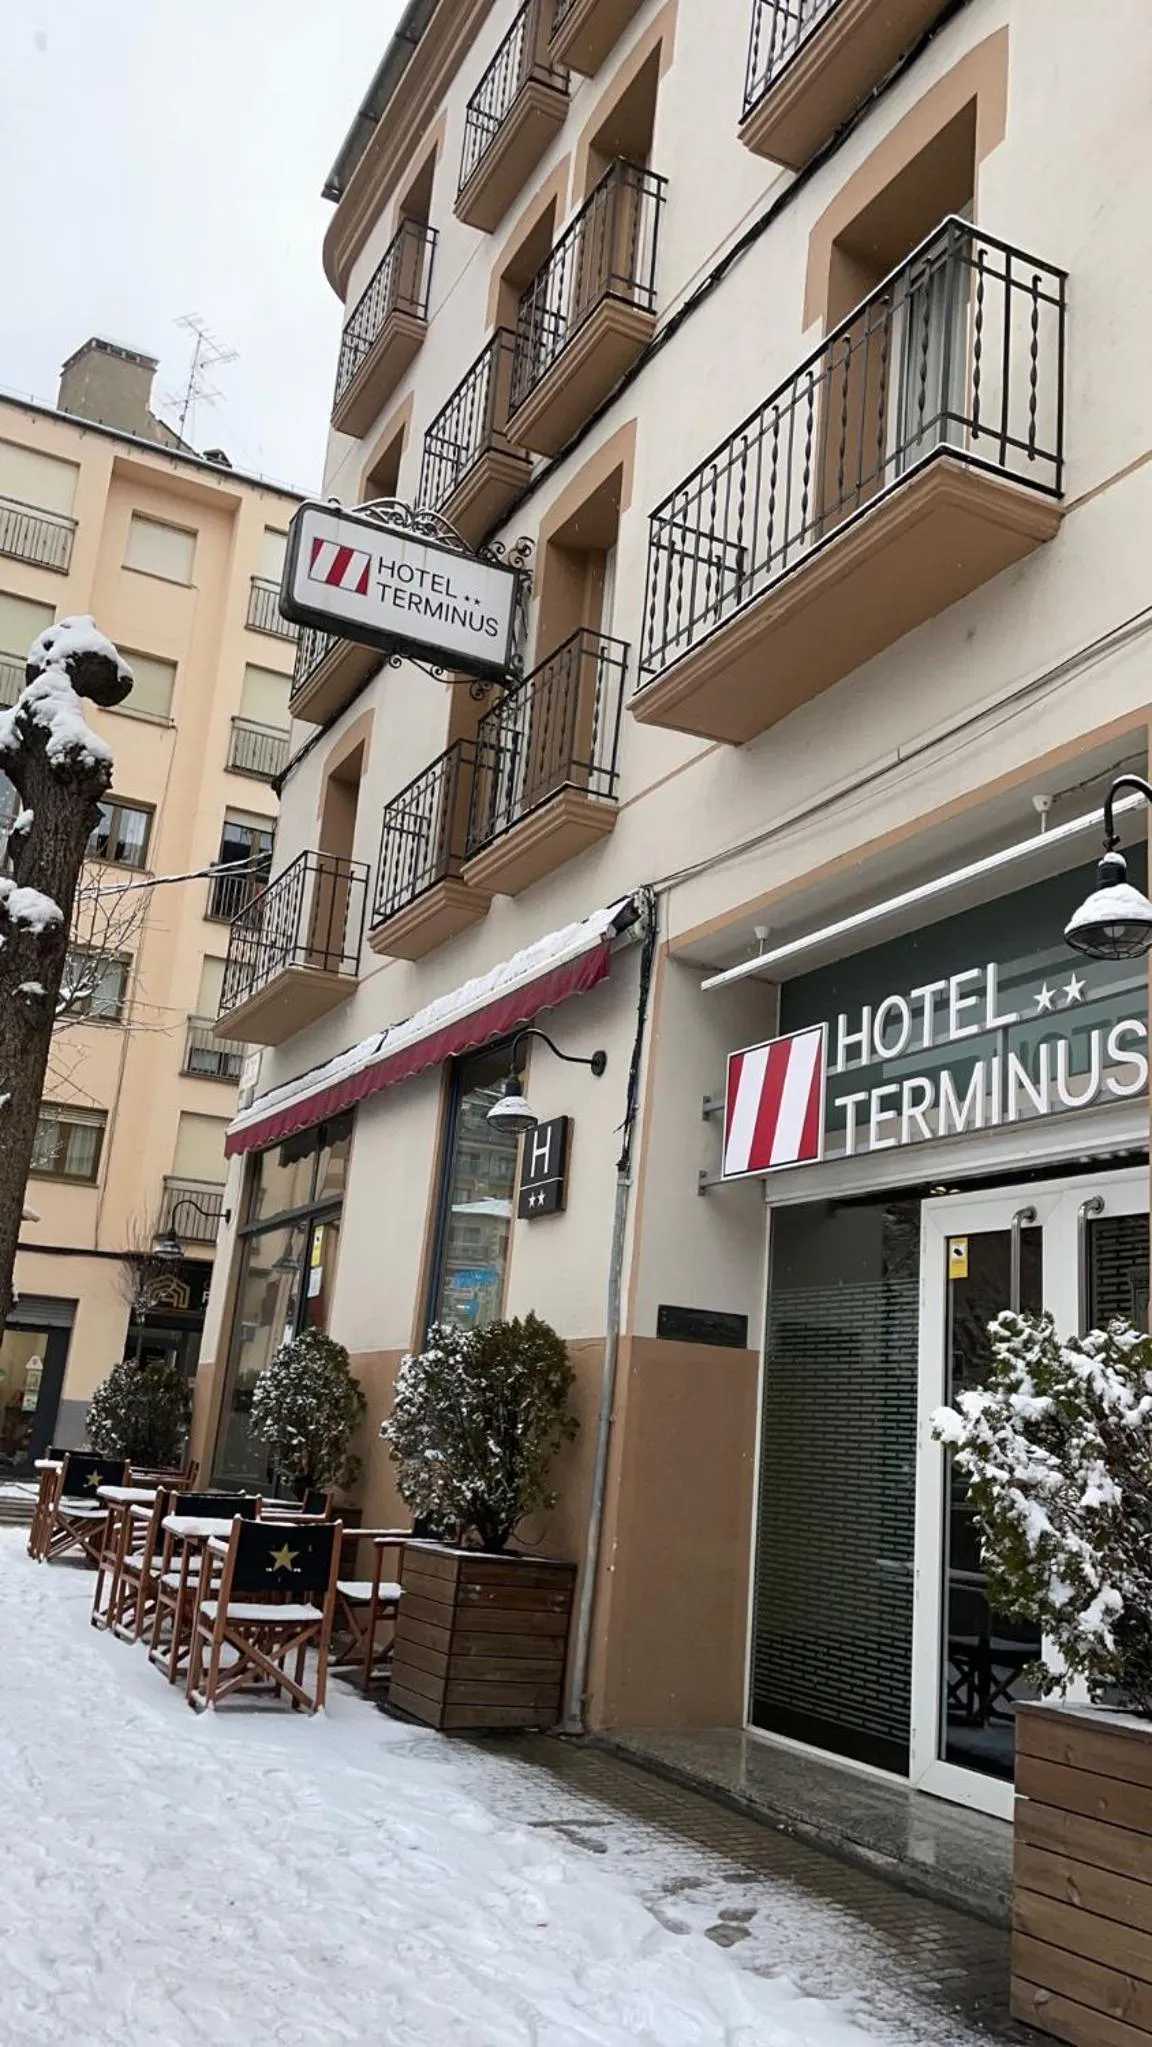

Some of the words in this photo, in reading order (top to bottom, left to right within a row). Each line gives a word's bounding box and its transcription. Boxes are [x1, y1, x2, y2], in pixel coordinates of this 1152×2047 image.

[377, 556, 457, 599] HOTEL
[377, 582, 499, 637] TERMINUS
[836, 962, 1020, 1072] HOTEL
[834, 1018, 1149, 1155] TERMINUS
[530, 1126, 552, 1177] H
